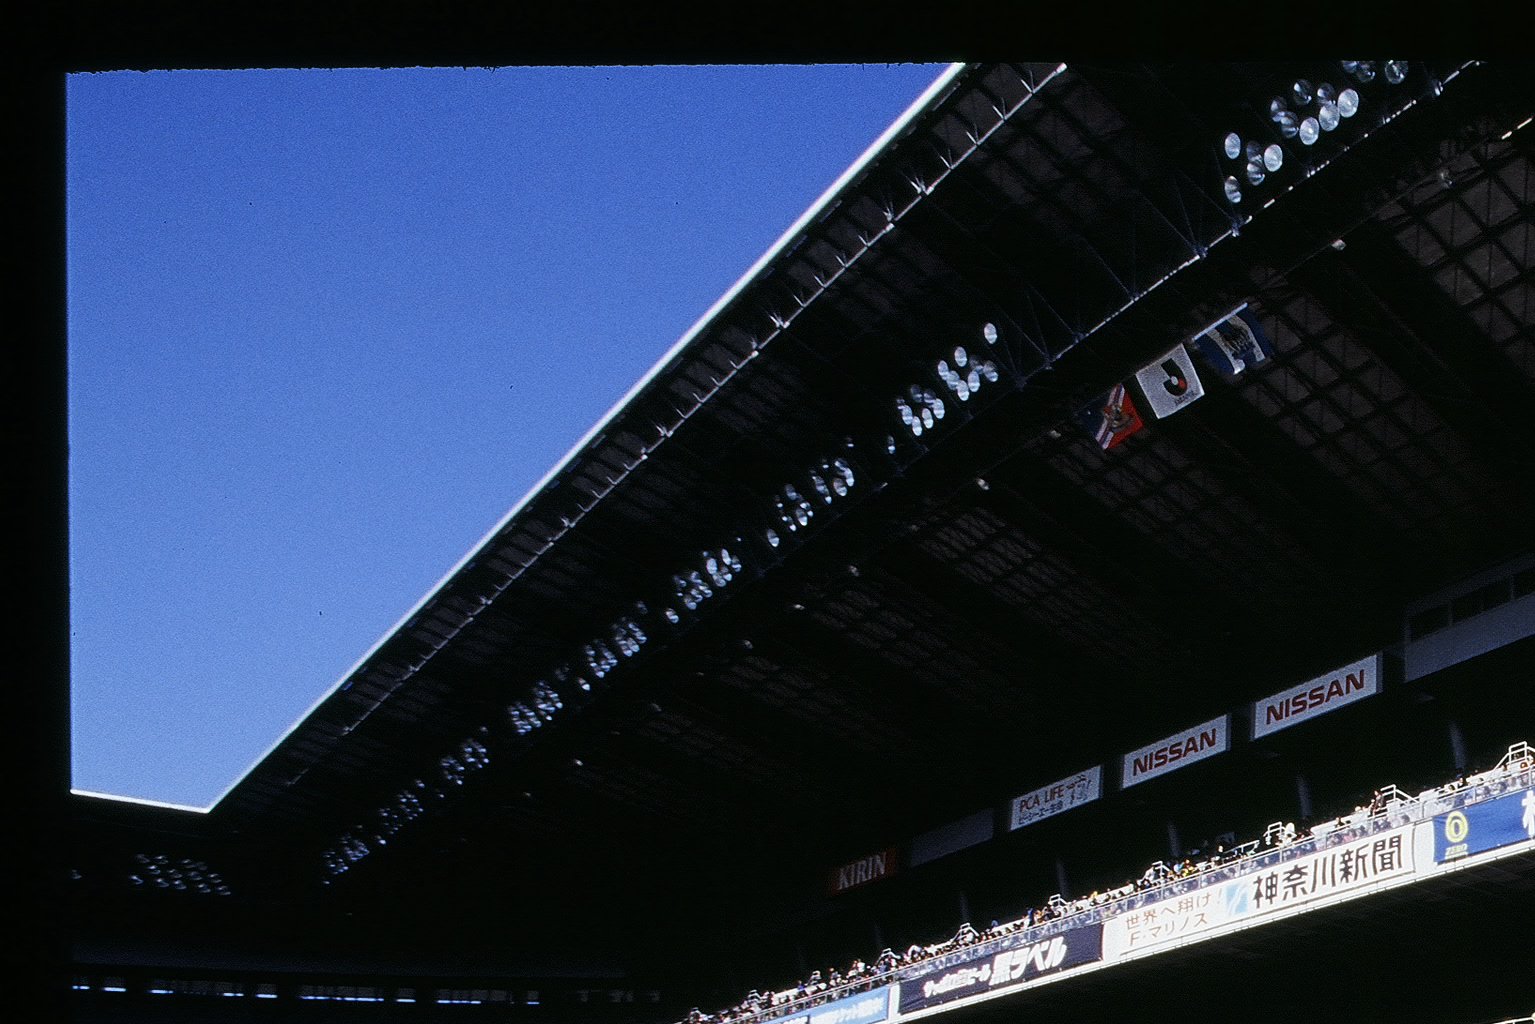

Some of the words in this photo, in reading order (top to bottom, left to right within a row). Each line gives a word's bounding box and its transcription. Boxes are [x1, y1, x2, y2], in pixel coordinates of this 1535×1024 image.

[1266, 668, 1366, 725] NISSAN
[1132, 727, 1217, 777] NISSAN
[1019, 794, 1040, 812] PCA
[1044, 784, 1065, 803] LIFE
[836, 851, 887, 890] KIRIN
[1253, 833, 1402, 909] 神奈川新聞
